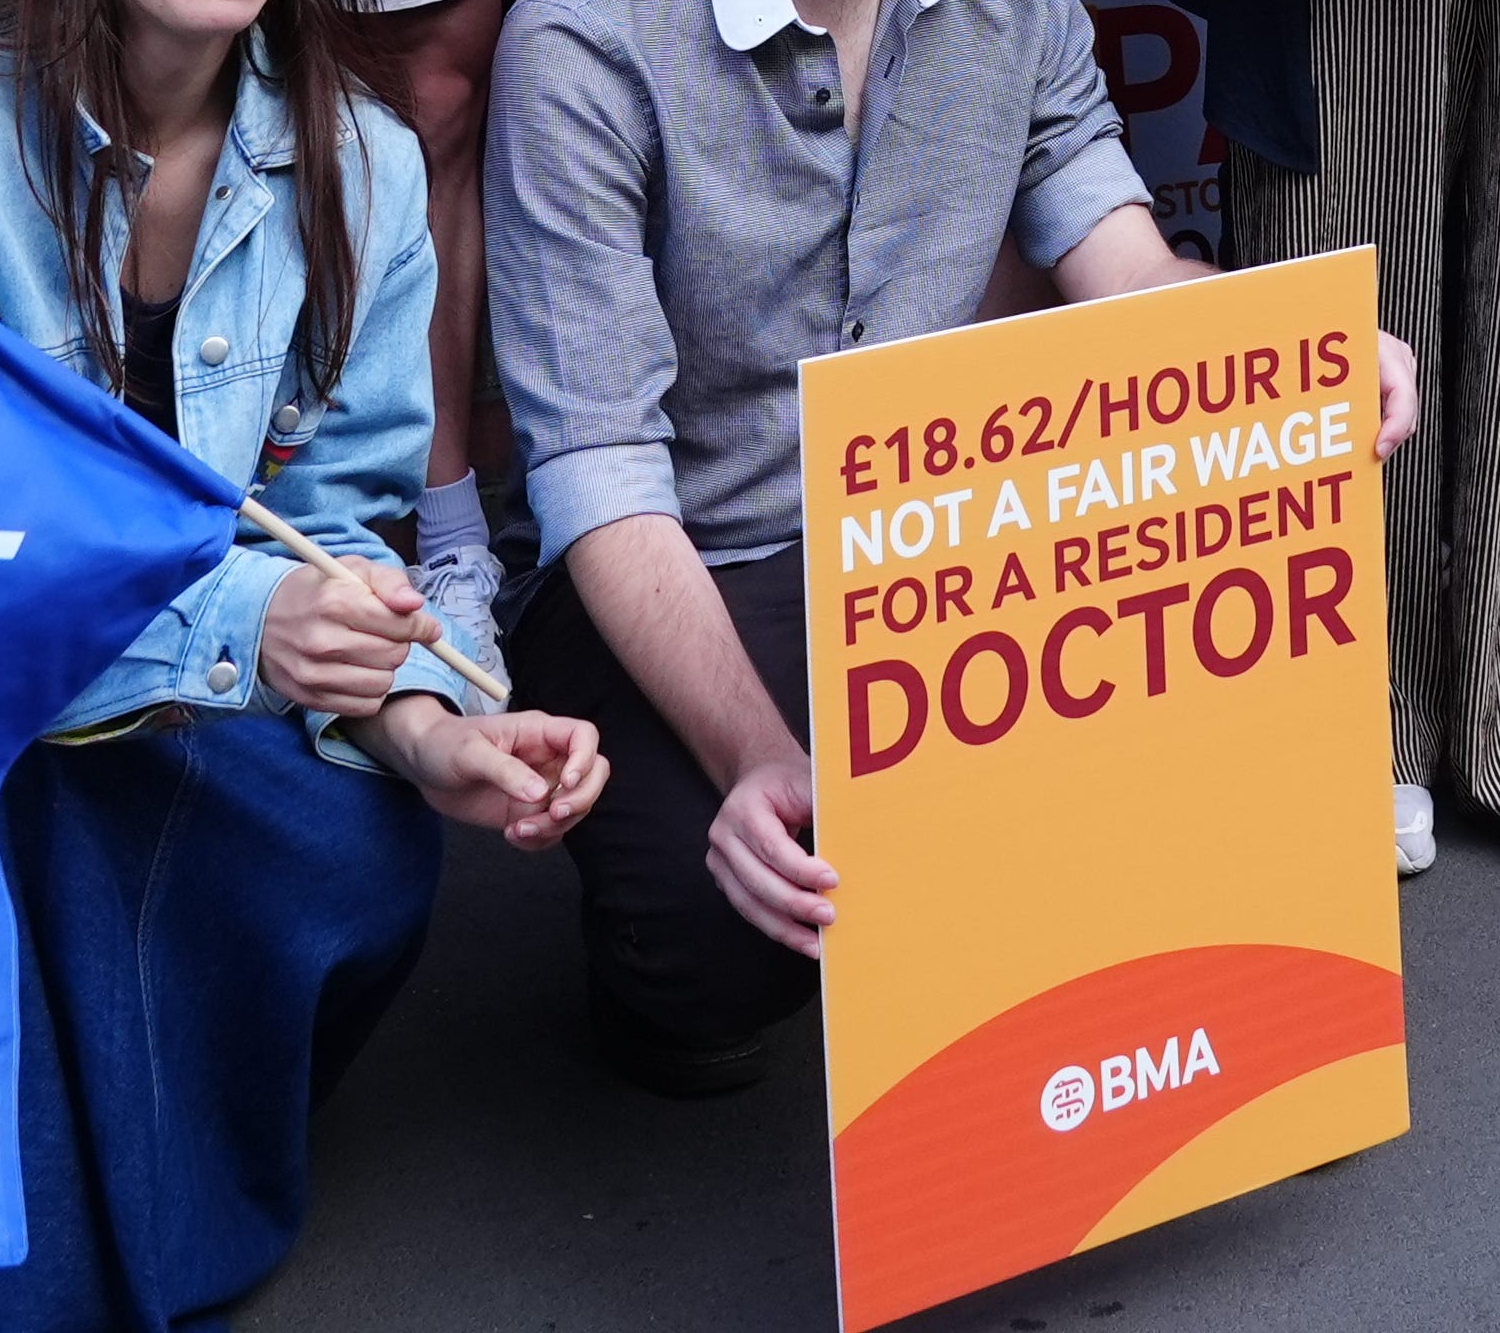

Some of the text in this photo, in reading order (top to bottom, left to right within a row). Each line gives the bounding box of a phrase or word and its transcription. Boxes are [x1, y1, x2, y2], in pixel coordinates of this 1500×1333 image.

[840, 332, 1349, 495] £18.62/HOUR IS
[842, 402, 1352, 572] NOT A FAIR WAGE
[845, 471, 1352, 646] FOR A RESIDENT
[847, 547, 1356, 778] DOCTOR
[1101, 1028, 1220, 1111] BMA
